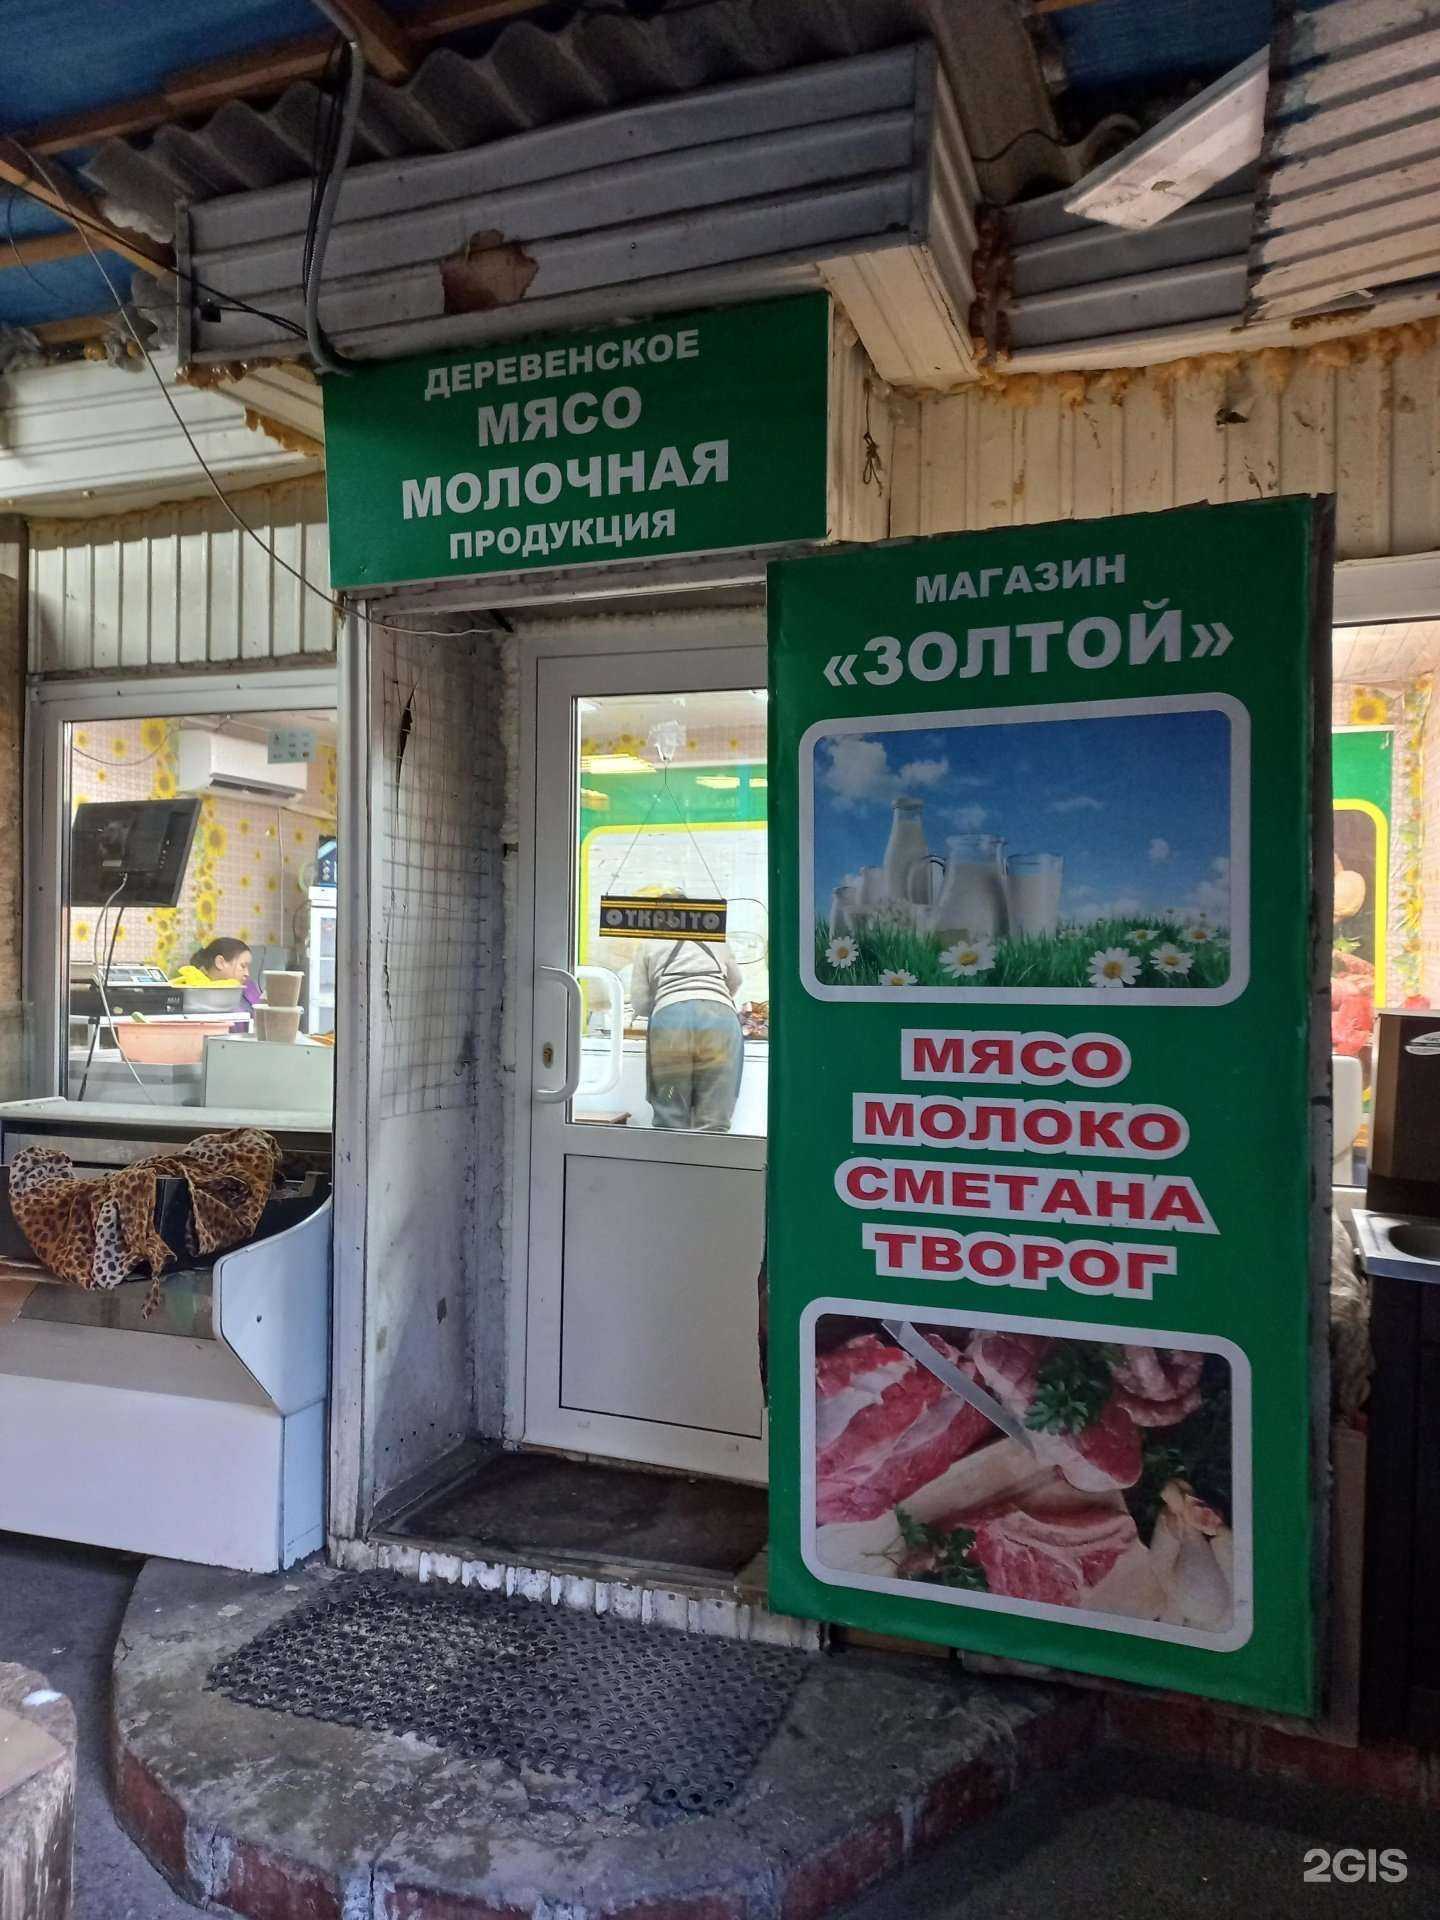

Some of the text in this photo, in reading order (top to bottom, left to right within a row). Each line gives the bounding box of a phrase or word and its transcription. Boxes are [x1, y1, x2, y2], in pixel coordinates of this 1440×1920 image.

[424, 329, 700, 401] ДЕРЕВЕНСКОЕ
[477, 385, 643, 448] МЯСО
[401, 438, 730, 521] МОЛОЧНАЯ
[449, 508, 677, 560] ПРОДУКЦИЯ
[914, 553, 1127, 605] МАГАЗИН
[822, 598, 1235, 688] «ЗОЛТОЙ»
[605, 908, 720, 931] ОТКРЫТО
[911, 1036, 1124, 1080] МЯСО
[862, 1100, 1183, 1153] МОЛОКО
[844, 1164, 1206, 1226] СМЕТАНА
[872, 1231, 1170, 1292] ТВОРОГ
